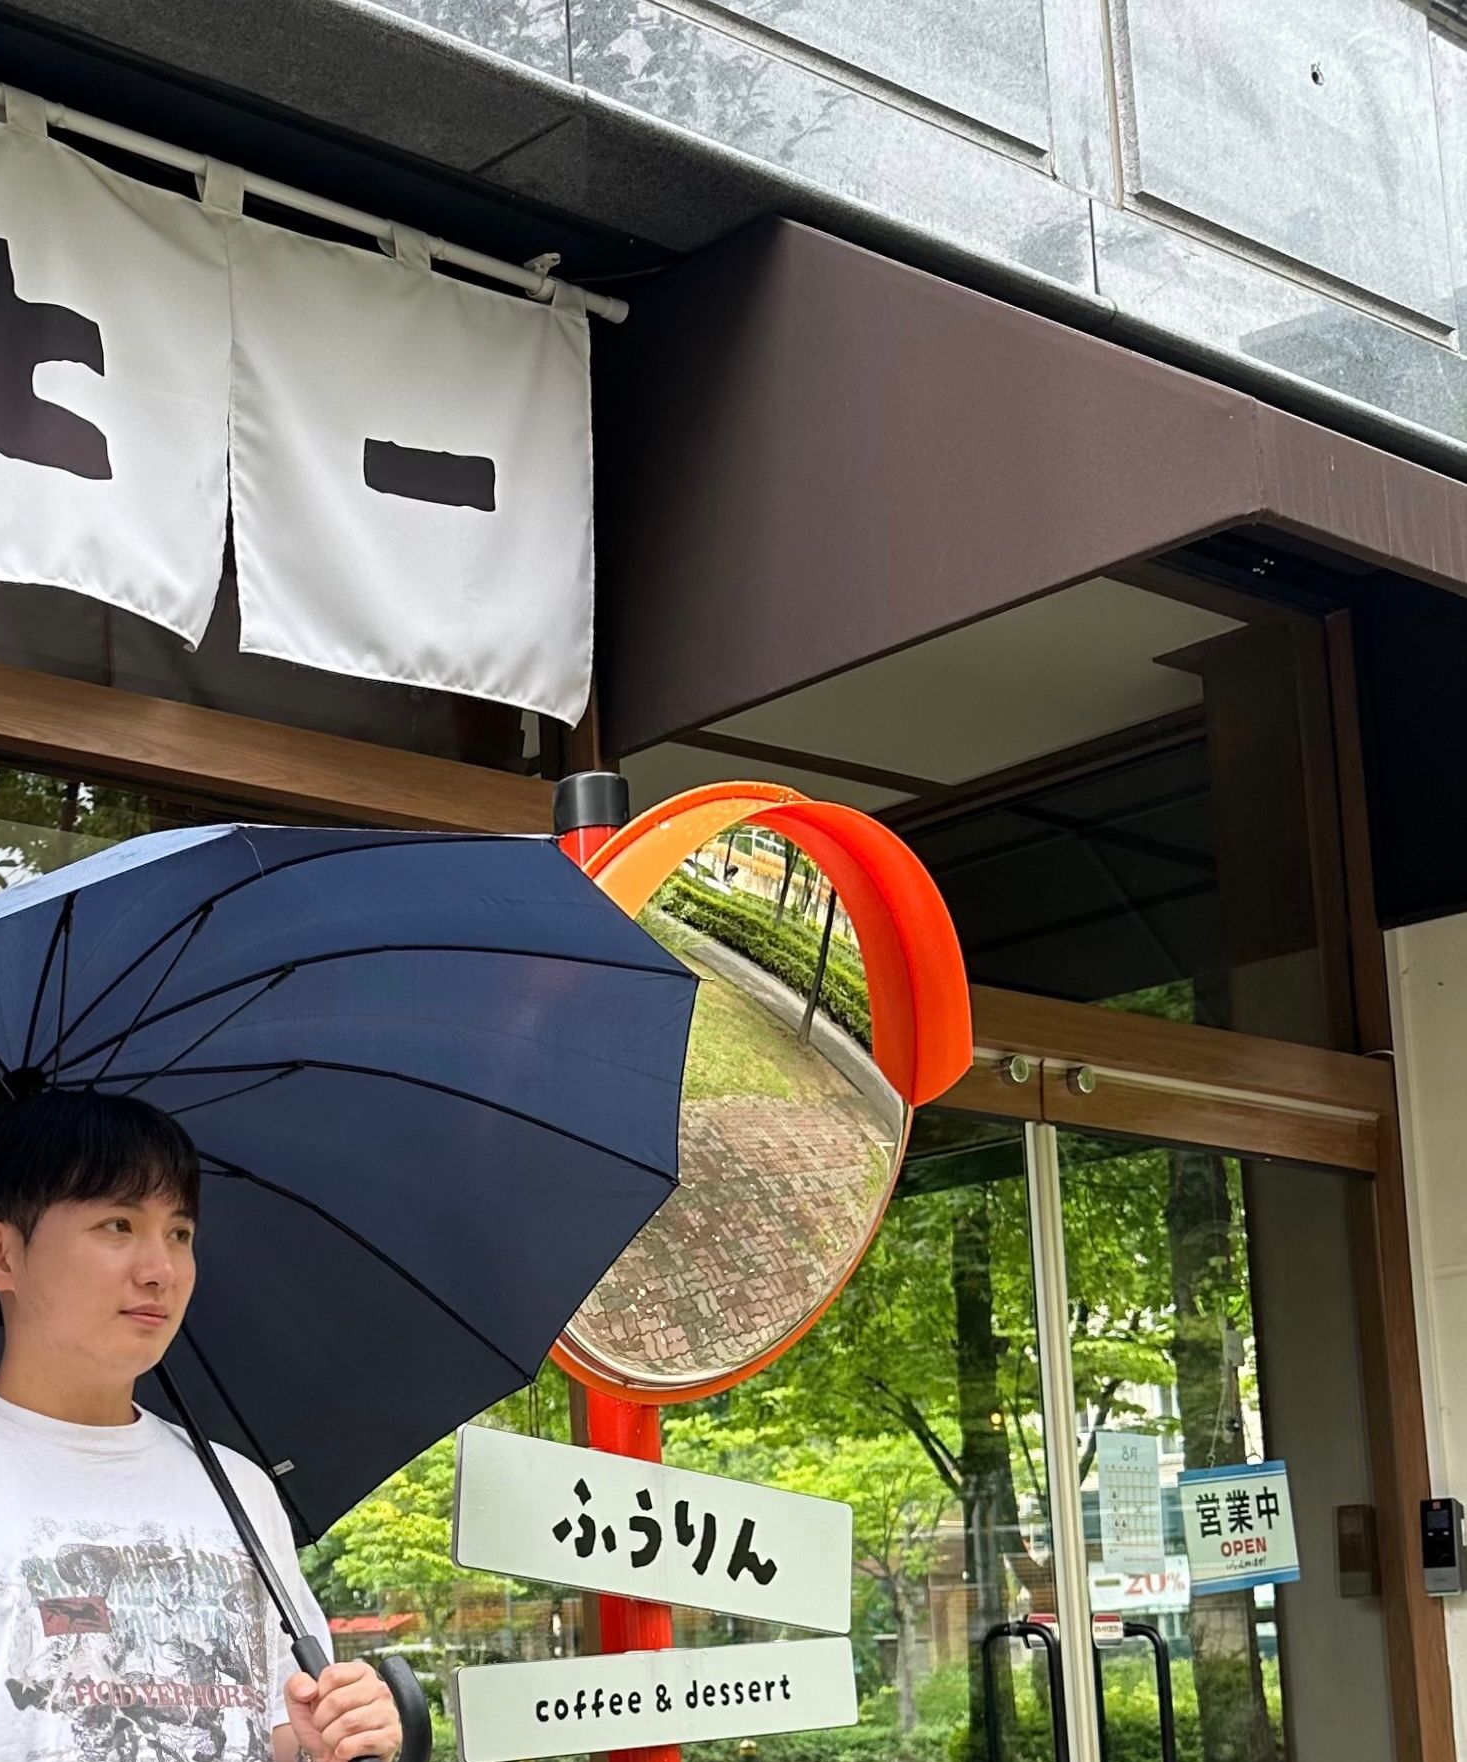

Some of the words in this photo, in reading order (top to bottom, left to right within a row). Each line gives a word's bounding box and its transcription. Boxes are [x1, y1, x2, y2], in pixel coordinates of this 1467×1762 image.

[552, 1478, 778, 1586] ふうりん
[1195, 1485, 1280, 1538] 営業中
[1220, 1536, 1267, 1557] OPEN
[535, 1687, 642, 1723] coffee
[655, 1684, 672, 1713] &
[685, 1674, 792, 1709] dessert
